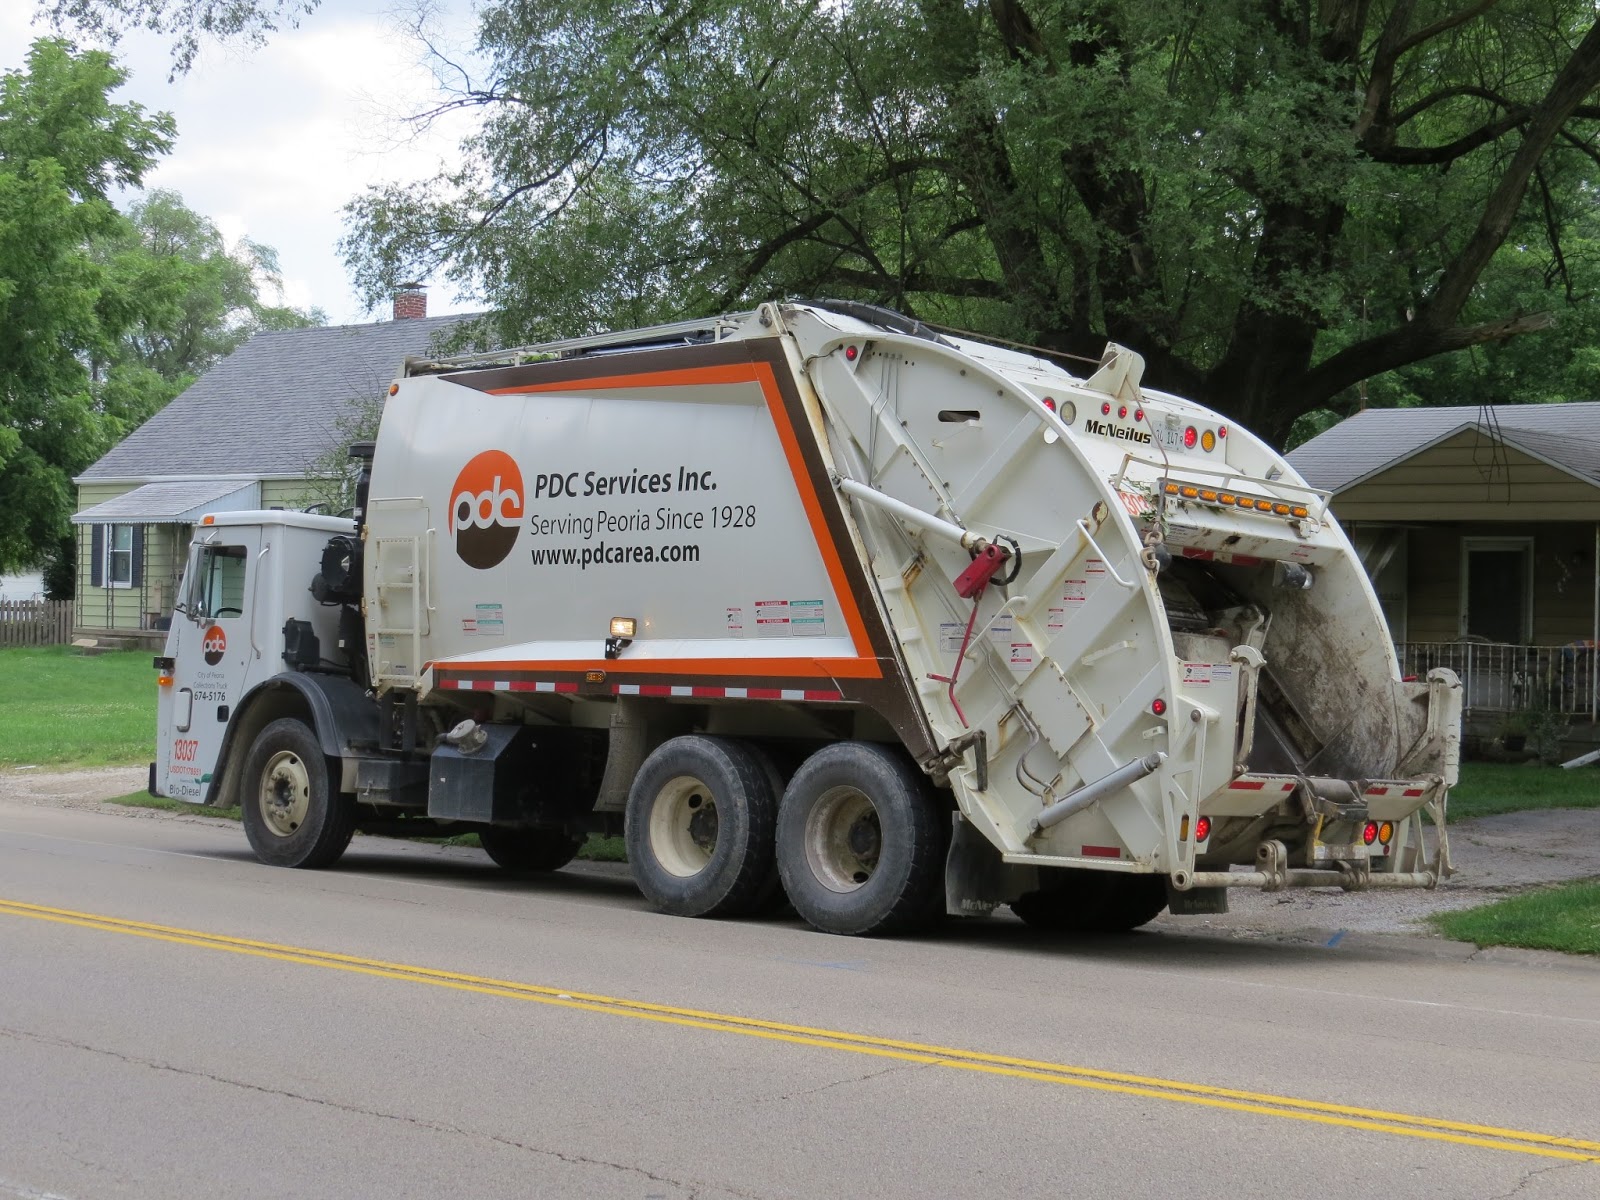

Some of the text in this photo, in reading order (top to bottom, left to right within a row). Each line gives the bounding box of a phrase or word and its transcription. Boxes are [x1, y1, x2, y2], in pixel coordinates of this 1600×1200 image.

[1084, 419, 1152, 444] McNeilus
[535, 466, 717, 499] PDC Services Inc.
[452, 475, 522, 546] pdc
[531, 505, 756, 540] Serving Peoria Since 1928
[531, 541, 700, 570] www.pdcarea.com
[194, 691, 226, 702] 674-5176
[175, 739, 199, 762] 13037
[170, 784, 201, 797] Bio-Diesel
